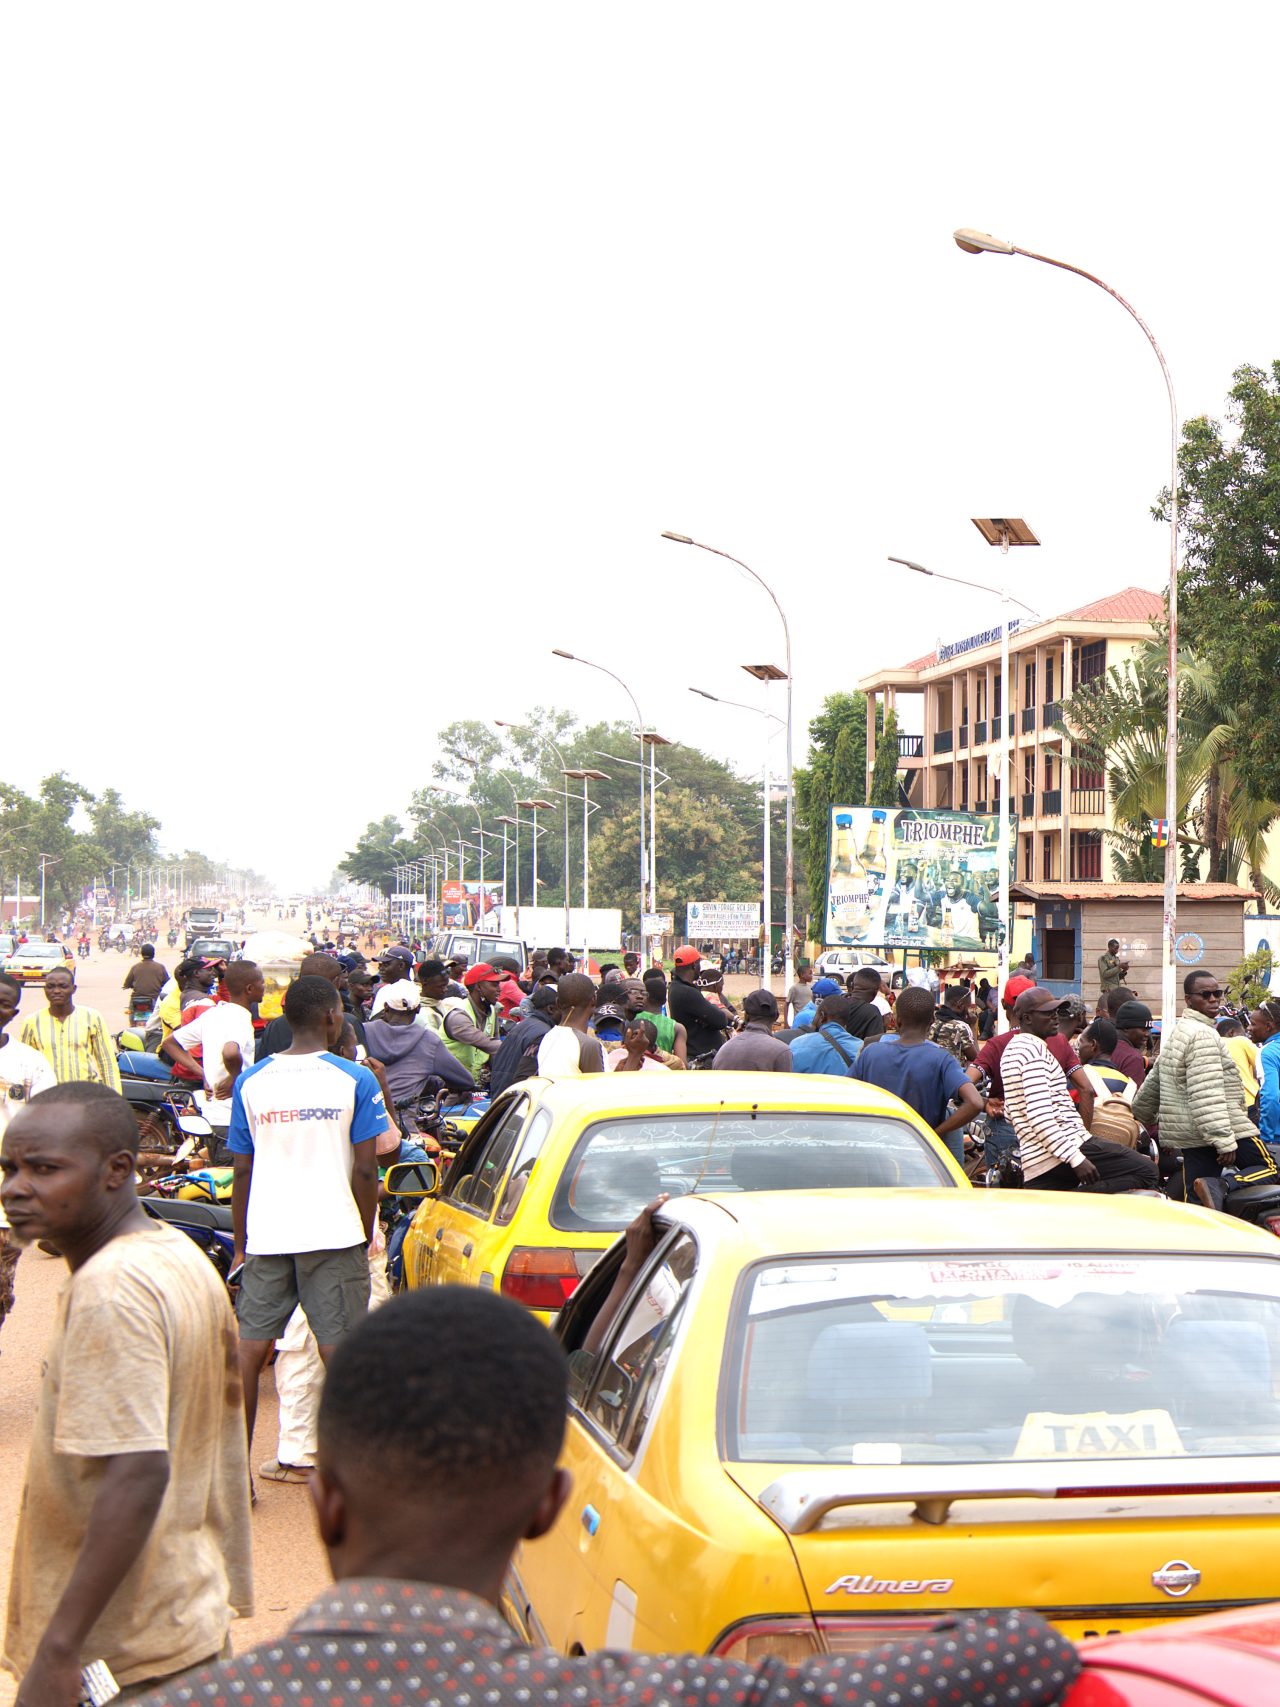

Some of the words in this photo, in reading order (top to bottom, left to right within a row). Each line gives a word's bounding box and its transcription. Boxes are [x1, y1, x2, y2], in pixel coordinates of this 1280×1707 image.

[902, 821, 984, 847] TRIOMPHE
[831, 893, 870, 905] TRIOMPHE
[1044, 1424, 1157, 1452] TAXI
[825, 1574, 954, 1594] Almera
